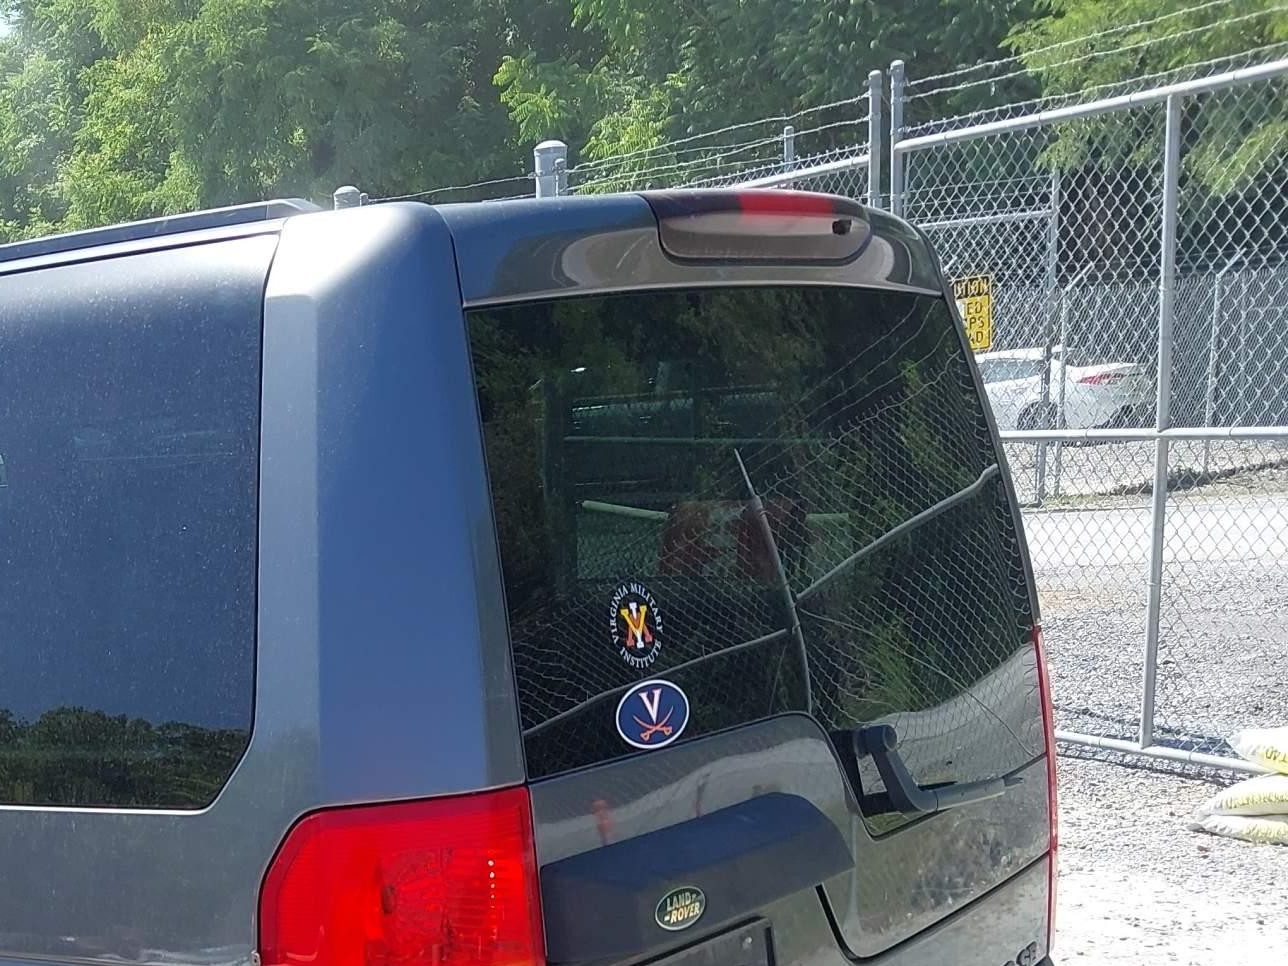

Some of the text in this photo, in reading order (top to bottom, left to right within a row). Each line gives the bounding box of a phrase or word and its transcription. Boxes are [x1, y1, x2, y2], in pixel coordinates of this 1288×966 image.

[610, 583, 664, 644] VIRGINIA MILITARY
[620, 639, 662, 669] INSTITUTE
[666, 892, 692, 912] LAND
[670, 902, 700, 924] ROVER
